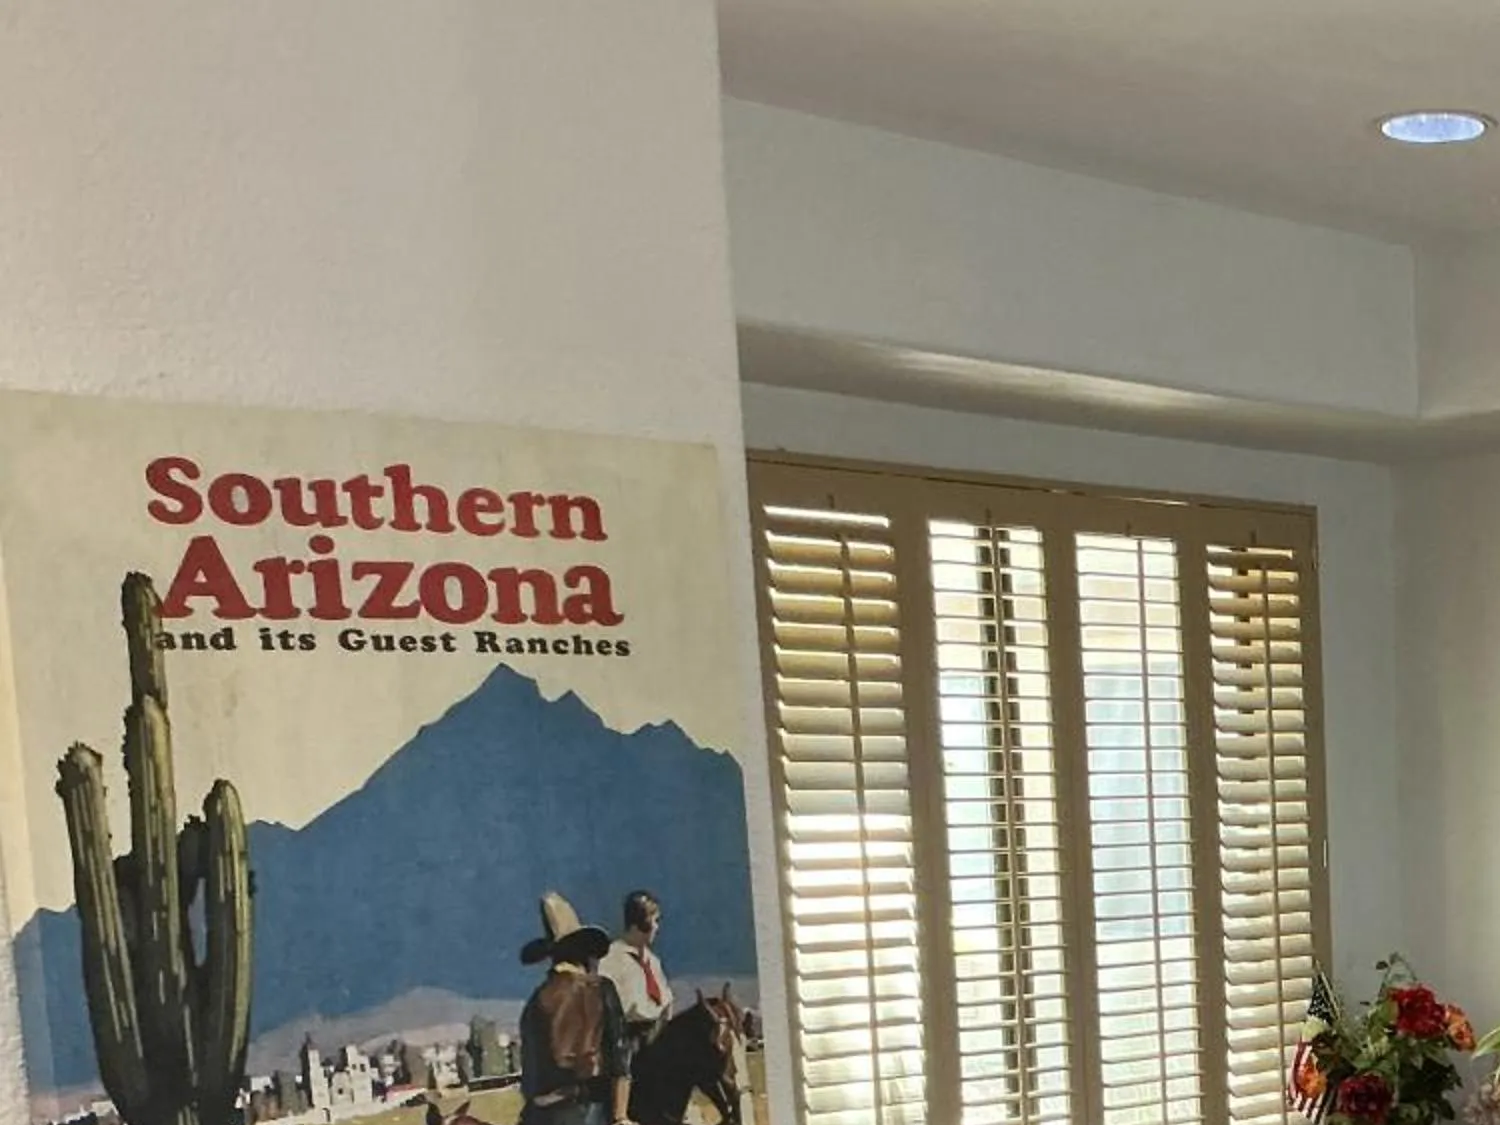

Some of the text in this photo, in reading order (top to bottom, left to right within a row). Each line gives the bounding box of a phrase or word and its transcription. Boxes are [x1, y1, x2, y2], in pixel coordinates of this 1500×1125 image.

[145, 456, 609, 542] Southern
[155, 535, 625, 627] Arizona
[155, 627, 632, 658] and its Guest Ranches
